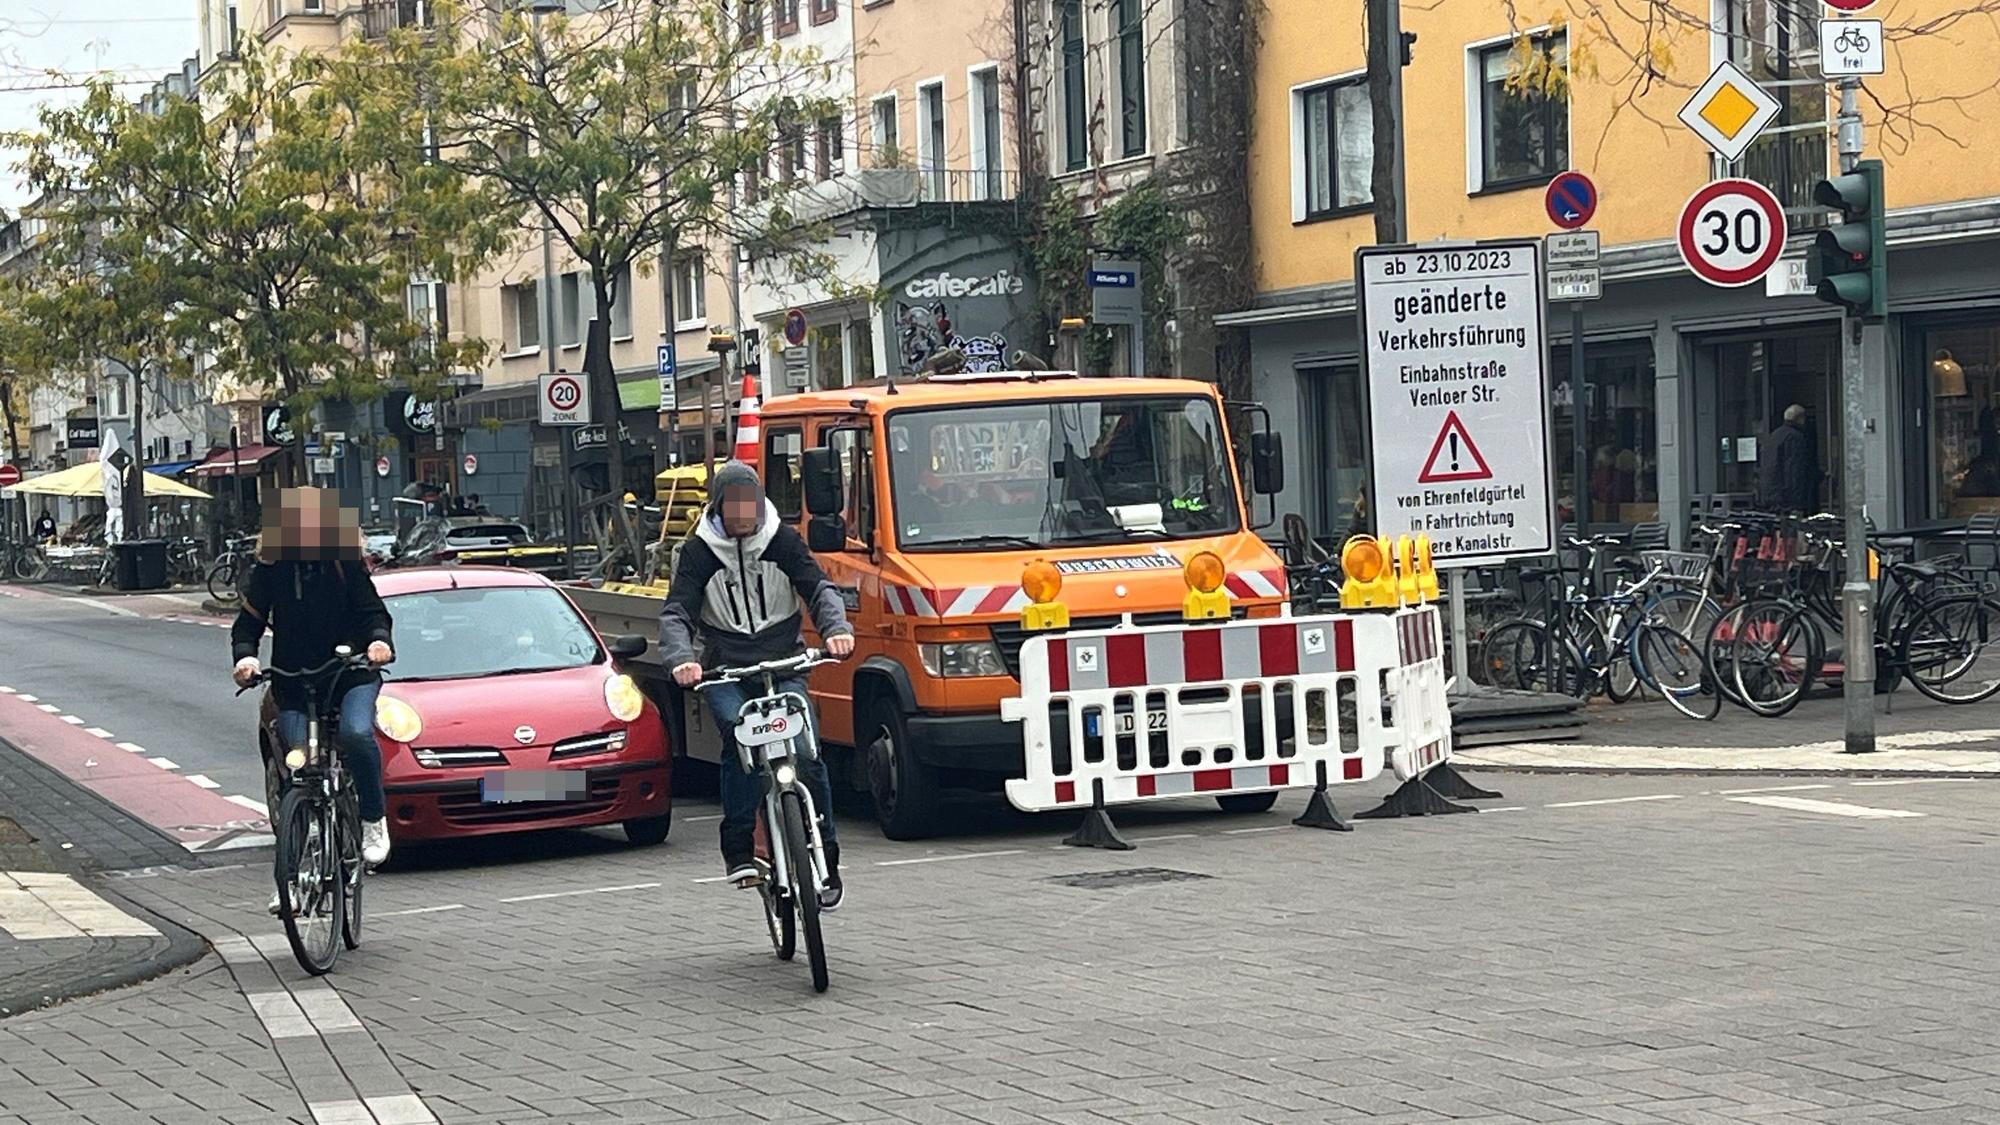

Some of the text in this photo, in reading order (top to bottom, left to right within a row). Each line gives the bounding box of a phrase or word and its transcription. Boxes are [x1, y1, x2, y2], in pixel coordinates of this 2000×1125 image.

[1843, 56, 1863, 68] frei
[1702, 209, 1762, 256] 30
[1384, 251, 1511, 276] ab 23.10.2023
[905, 269, 1023, 298] cafecafe
[1394, 284, 1507, 323] geänderte
[1379, 325, 1526, 351] Verkehrsführung
[660, 348, 669, 372] P
[745, 338, 760, 366] Ge
[1400, 360, 1507, 384] Einbahnstraße
[555, 386, 574, 401] 20
[1410, 385, 1500, 407] Venloer Str.
[552, 412, 577, 422] ZONE
[1397, 484, 1526, 508] von Ehrenfeldgürtel
[1411, 511, 1514, 531] in Fahrtrichtung
[1432, 533, 1515, 554] ere Kanalstr.
